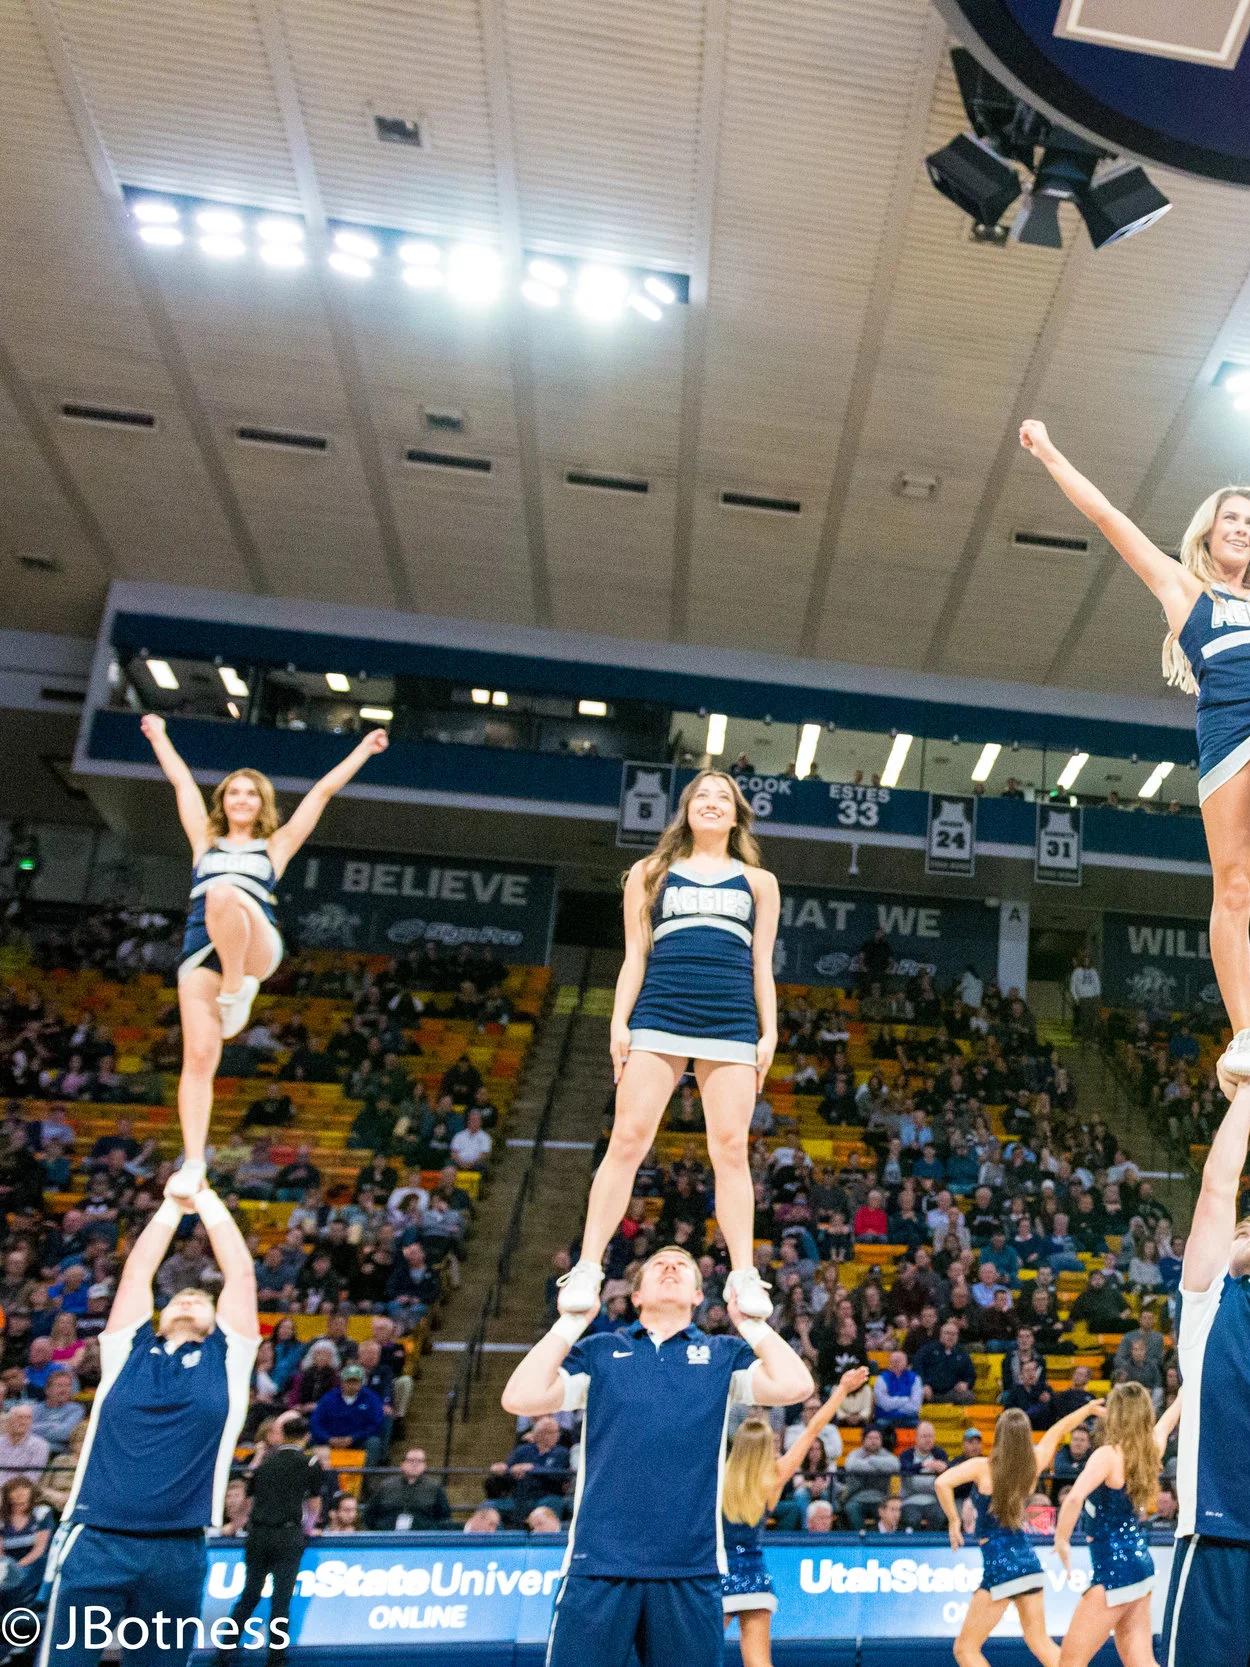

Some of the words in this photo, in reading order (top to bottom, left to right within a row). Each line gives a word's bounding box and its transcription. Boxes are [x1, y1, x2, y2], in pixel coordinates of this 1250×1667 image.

[737, 774, 792, 795] COOK
[828, 783, 892, 804] ESTES
[639, 802, 651, 819] 5
[751, 791, 773, 817] 6
[838, 800, 879, 826] 33
[936, 830, 966, 849] 24
[1047, 841, 1071, 858] 31
[304, 858, 320, 890] I
[342, 860, 531, 906] BELIEVE
[662, 886, 752, 921] AGGIES
[1007, 906, 1021, 923] A
[779, 895, 856, 933] HAT
[876, 904, 942, 939] WE
[1127, 926, 1211, 961] WILL
[367, 1605, 469, 1630] ONLINE
